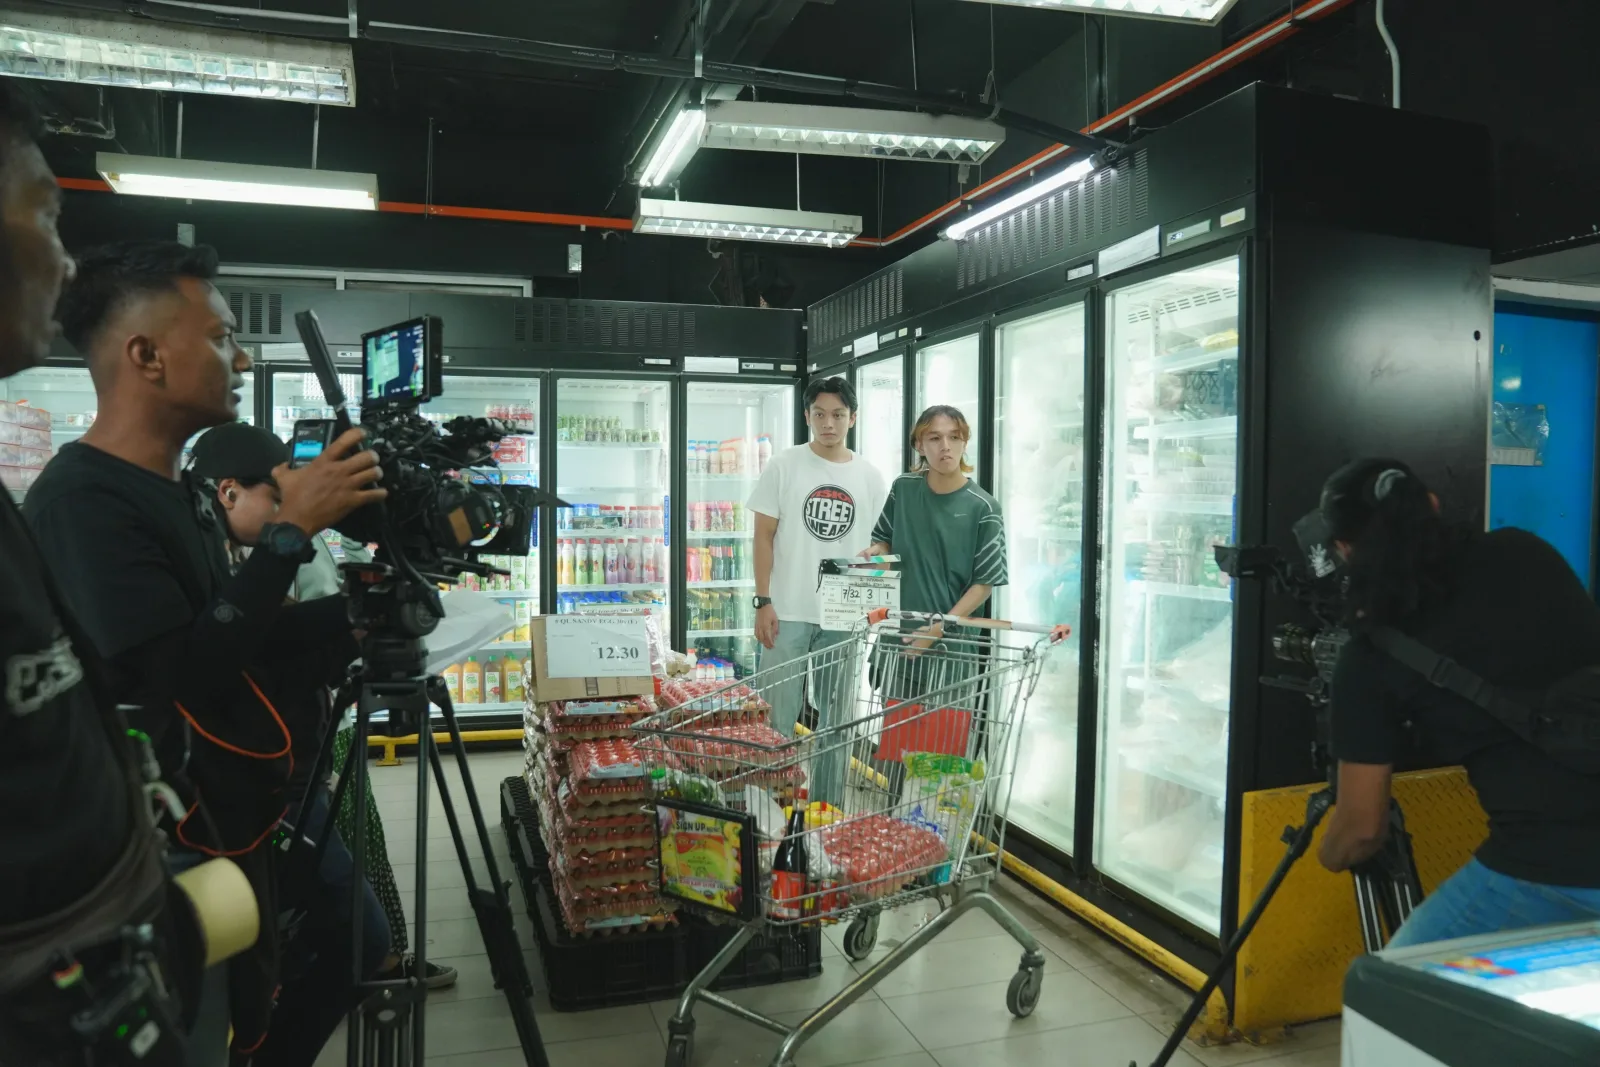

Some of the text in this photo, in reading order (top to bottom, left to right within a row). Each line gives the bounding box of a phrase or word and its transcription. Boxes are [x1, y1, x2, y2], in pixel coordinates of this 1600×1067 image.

[805, 497, 853, 523] STREET
[866, 588, 873, 599] 3
[598, 647, 639, 659] 12.30
[675, 821, 693, 831] SIGN
[695, 822, 706, 832] UP
